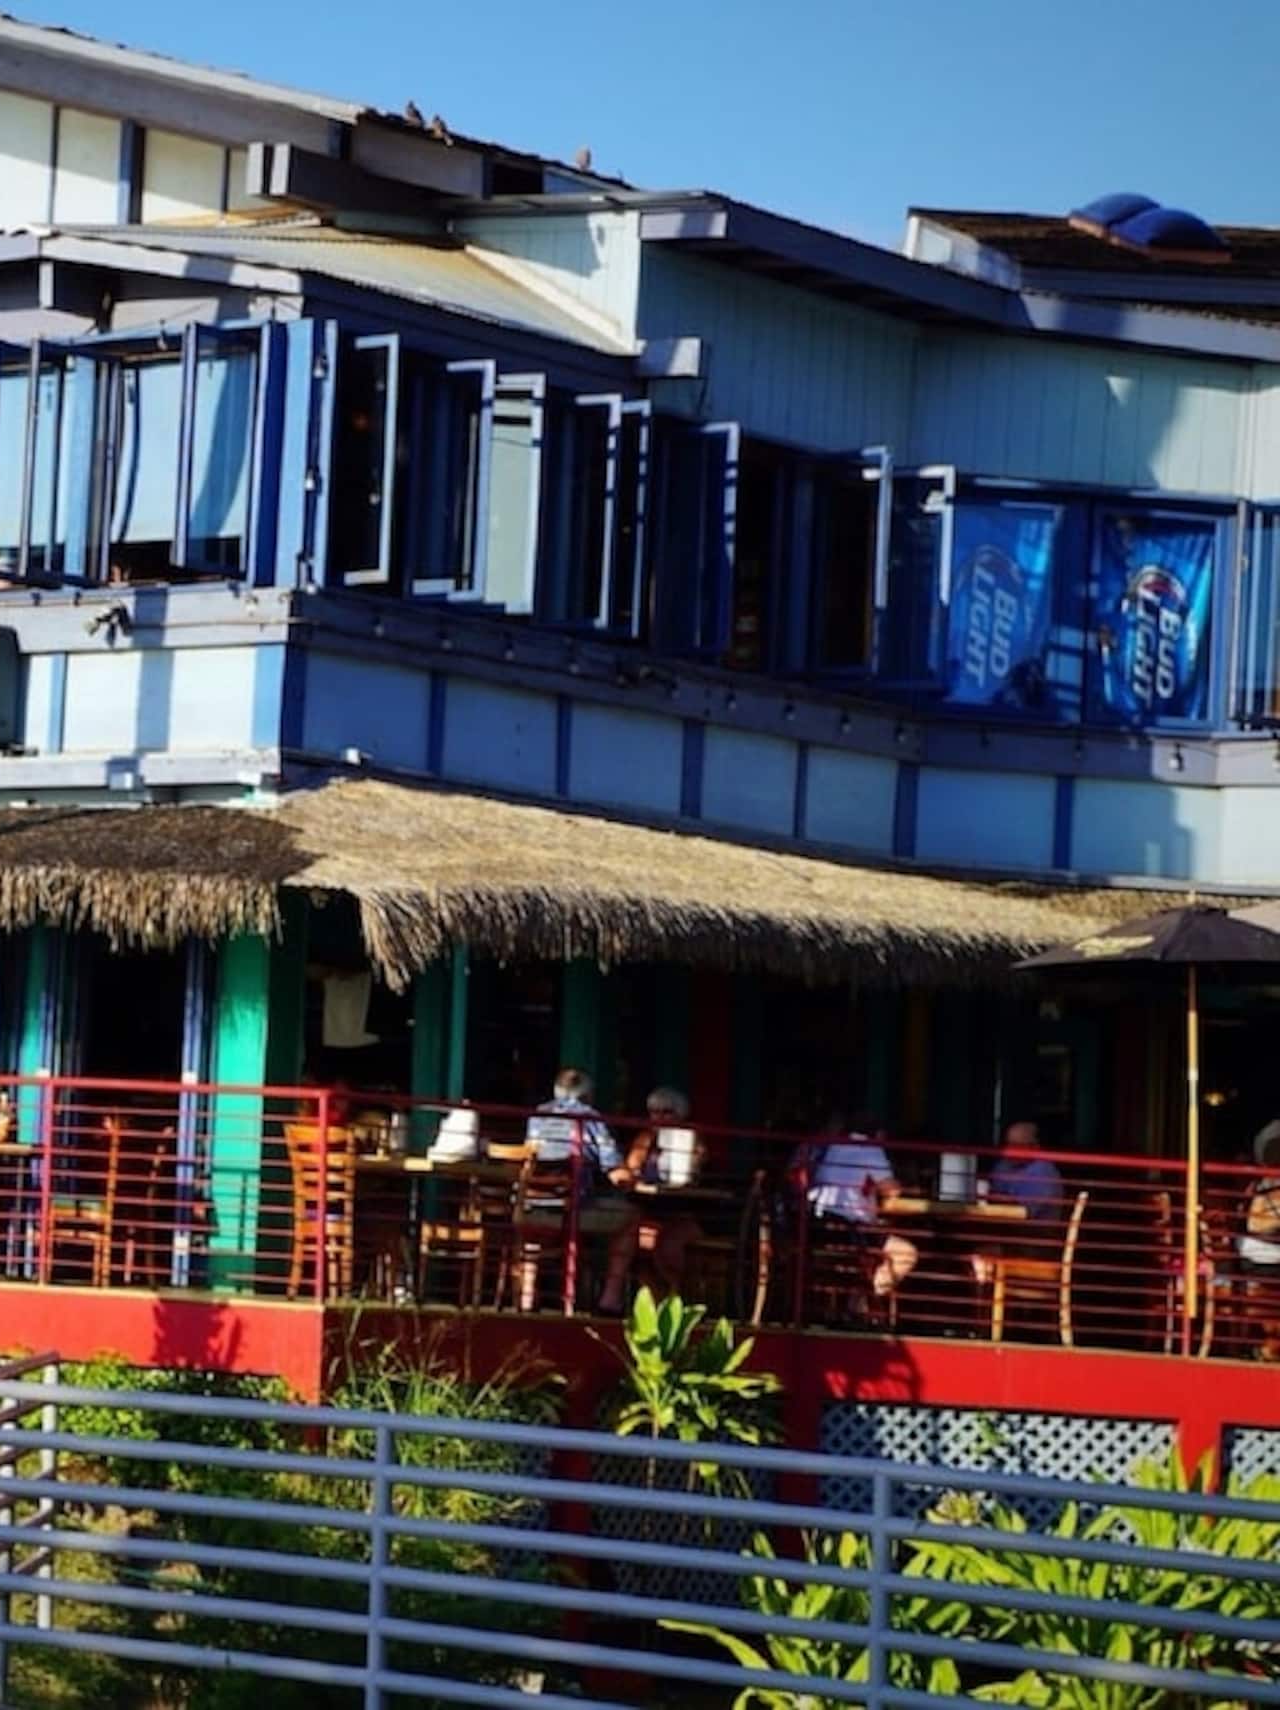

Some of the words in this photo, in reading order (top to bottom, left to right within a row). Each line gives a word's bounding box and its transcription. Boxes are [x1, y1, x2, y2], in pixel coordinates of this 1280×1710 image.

[964, 562, 995, 689] LIGHT
[989, 587, 1019, 678] BUD
[1132, 584, 1161, 710] LIGHT
[1156, 606, 1182, 700] BUD
